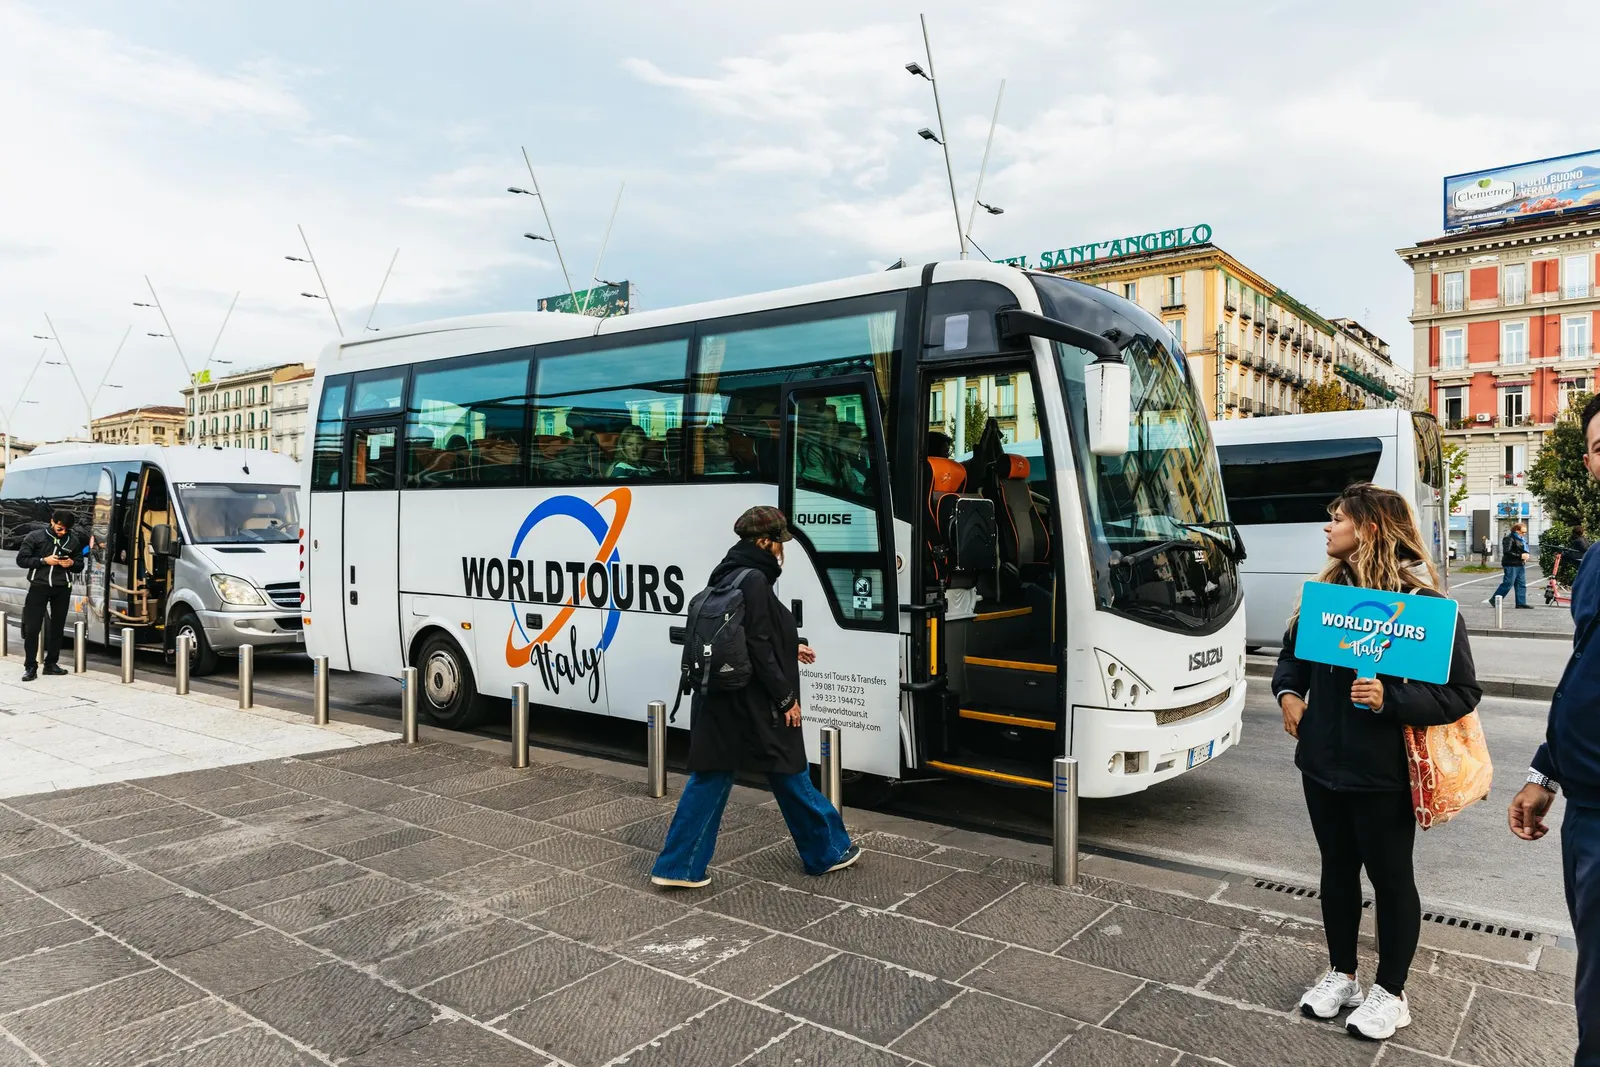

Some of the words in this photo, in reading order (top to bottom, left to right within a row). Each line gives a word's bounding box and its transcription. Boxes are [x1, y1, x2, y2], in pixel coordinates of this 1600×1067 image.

[1550, 170, 1583, 184] BUONO
[1457, 187, 1512, 203] Clemente
[1520, 181, 1573, 196] VERAMENTE
[1039, 223, 1213, 270] SANT'ANGELO
[177, 482, 196, 490] NCC
[794, 512, 852, 526] QUOISE
[462, 556, 685, 614] WORLDTOURS
[1321, 611, 1426, 641] WORLDTOURS
[1349, 638, 1386, 663] Italy
[530, 625, 602, 704] Italy
[1188, 646, 1224, 672] ISUZU
[799, 668, 823, 679] rldtours
[824, 671, 832, 680] srl
[832, 671, 850, 682] Tours
[851, 673, 857, 682] &
[857, 674, 887, 686] Transfers
[811, 681, 823, 690] +39
[823, 683, 835, 691] 081
[837, 684, 865, 695] 7673273
[811, 693, 824, 701] +39
[824, 695, 836, 703] 333
[838, 696, 866, 706] 1944752
[809, 704, 869, 718] info@worldtours.it
[801, 715, 881, 732] www.worldtoursitaly.com
